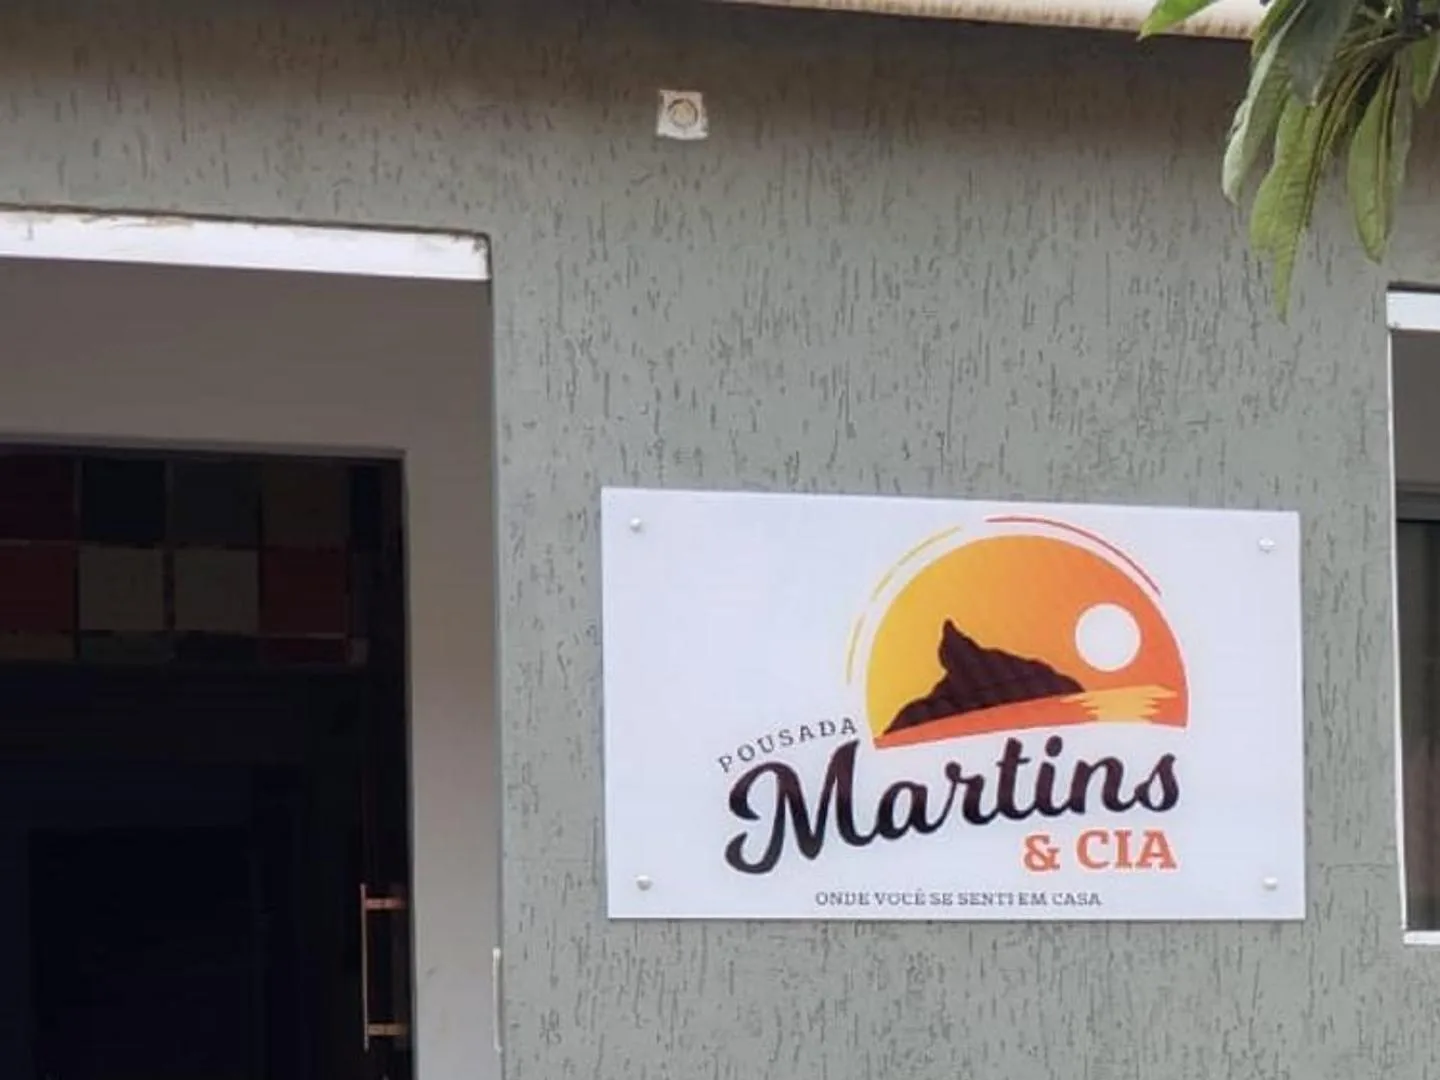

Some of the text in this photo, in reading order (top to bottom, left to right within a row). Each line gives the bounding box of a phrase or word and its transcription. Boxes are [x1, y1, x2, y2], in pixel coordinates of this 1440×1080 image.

[717, 716, 859, 773] POUSADA
[724, 735, 1181, 875] Martins
[1023, 828, 1178, 873] & CIA
[815, 890, 870, 906] ONDE
[929, 890, 952, 906] SE
[957, 890, 1013, 906] SENTI
[1017, 890, 1047, 906] EM
[1051, 890, 1102, 906] CASA
